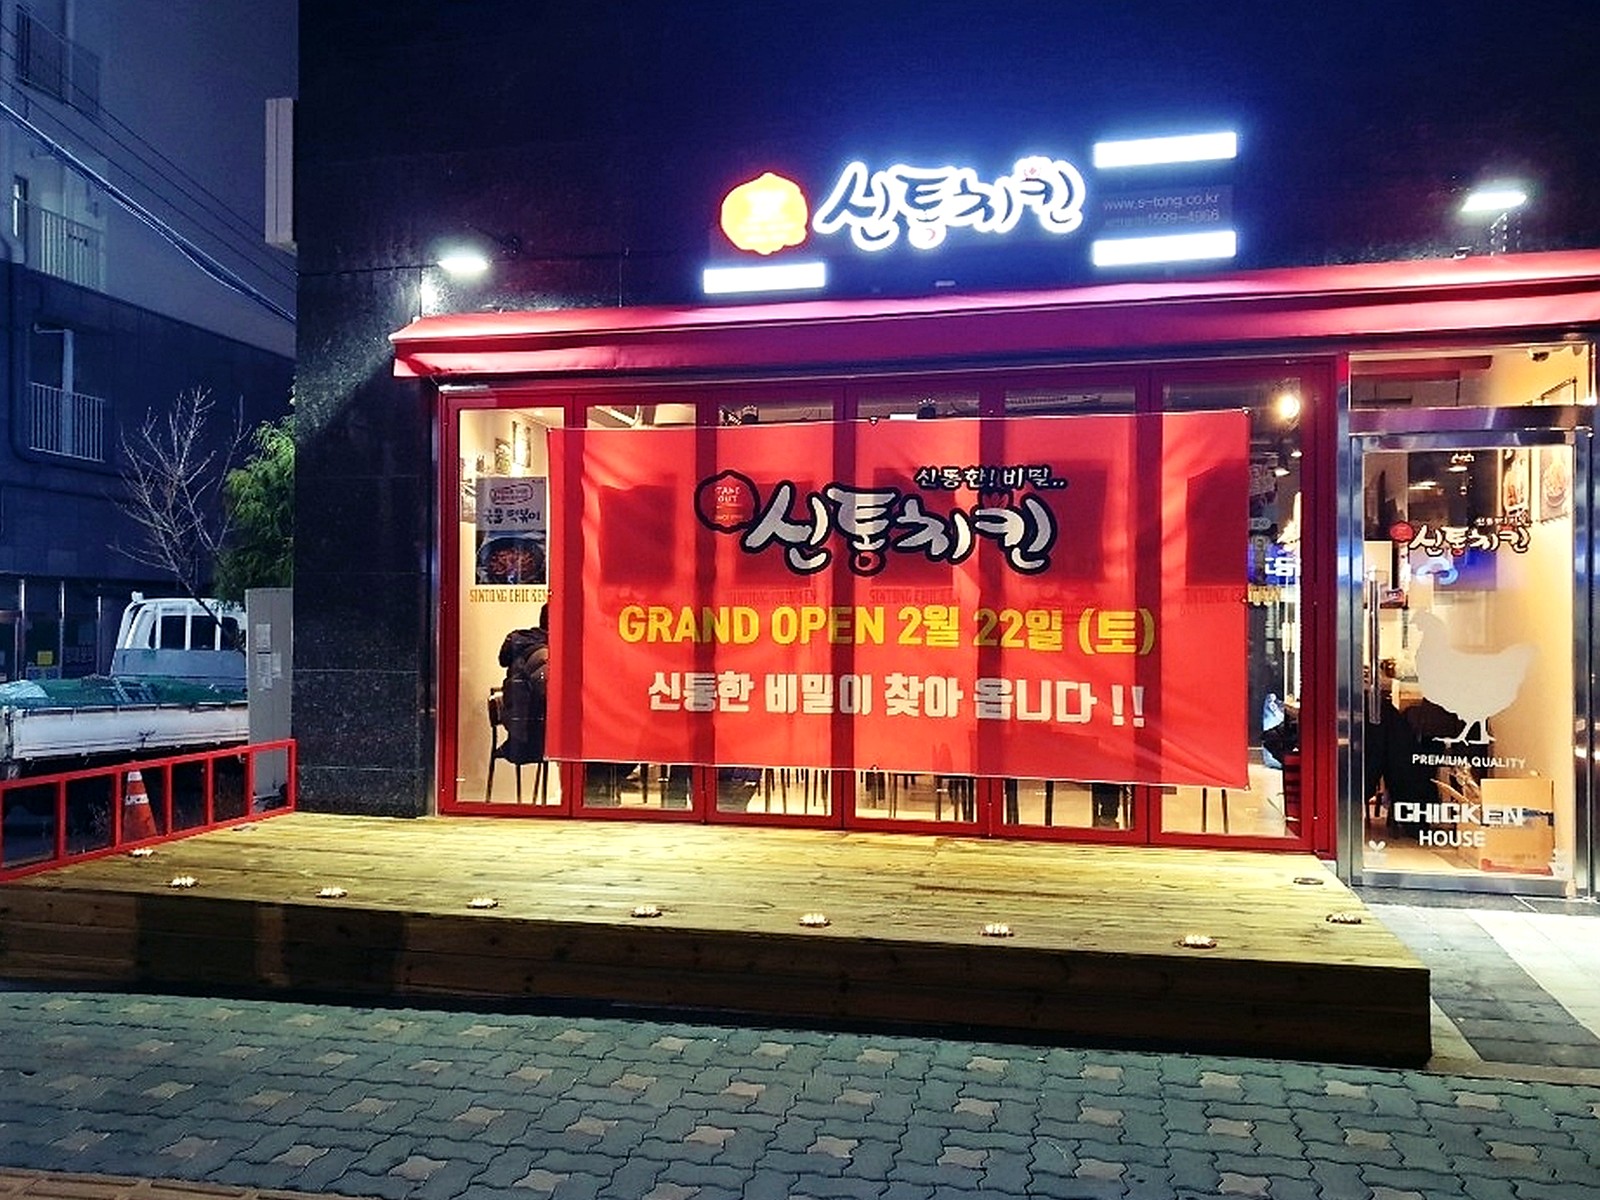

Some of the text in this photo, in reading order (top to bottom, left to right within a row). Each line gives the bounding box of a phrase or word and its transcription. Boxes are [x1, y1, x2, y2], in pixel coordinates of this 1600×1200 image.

[812, 156, 1086, 251] 신통치킨
[743, 481, 1055, 575] 신통치킨
[1408, 524, 1530, 557] 신통치킨
[618, 604, 1156, 656] GRAND OPEN 2월 22일 (토)
[648, 670, 755, 714] 신통한
[765, 673, 873, 716] 비밀이
[885, 672, 964, 719] 찾아
[973, 676, 1098, 724] 옵니다
[1411, 753, 1527, 770] PREMIUM QUALITY
[1393, 801, 1525, 827] CHICKEN
[1418, 829, 1487, 849] HOUSE
